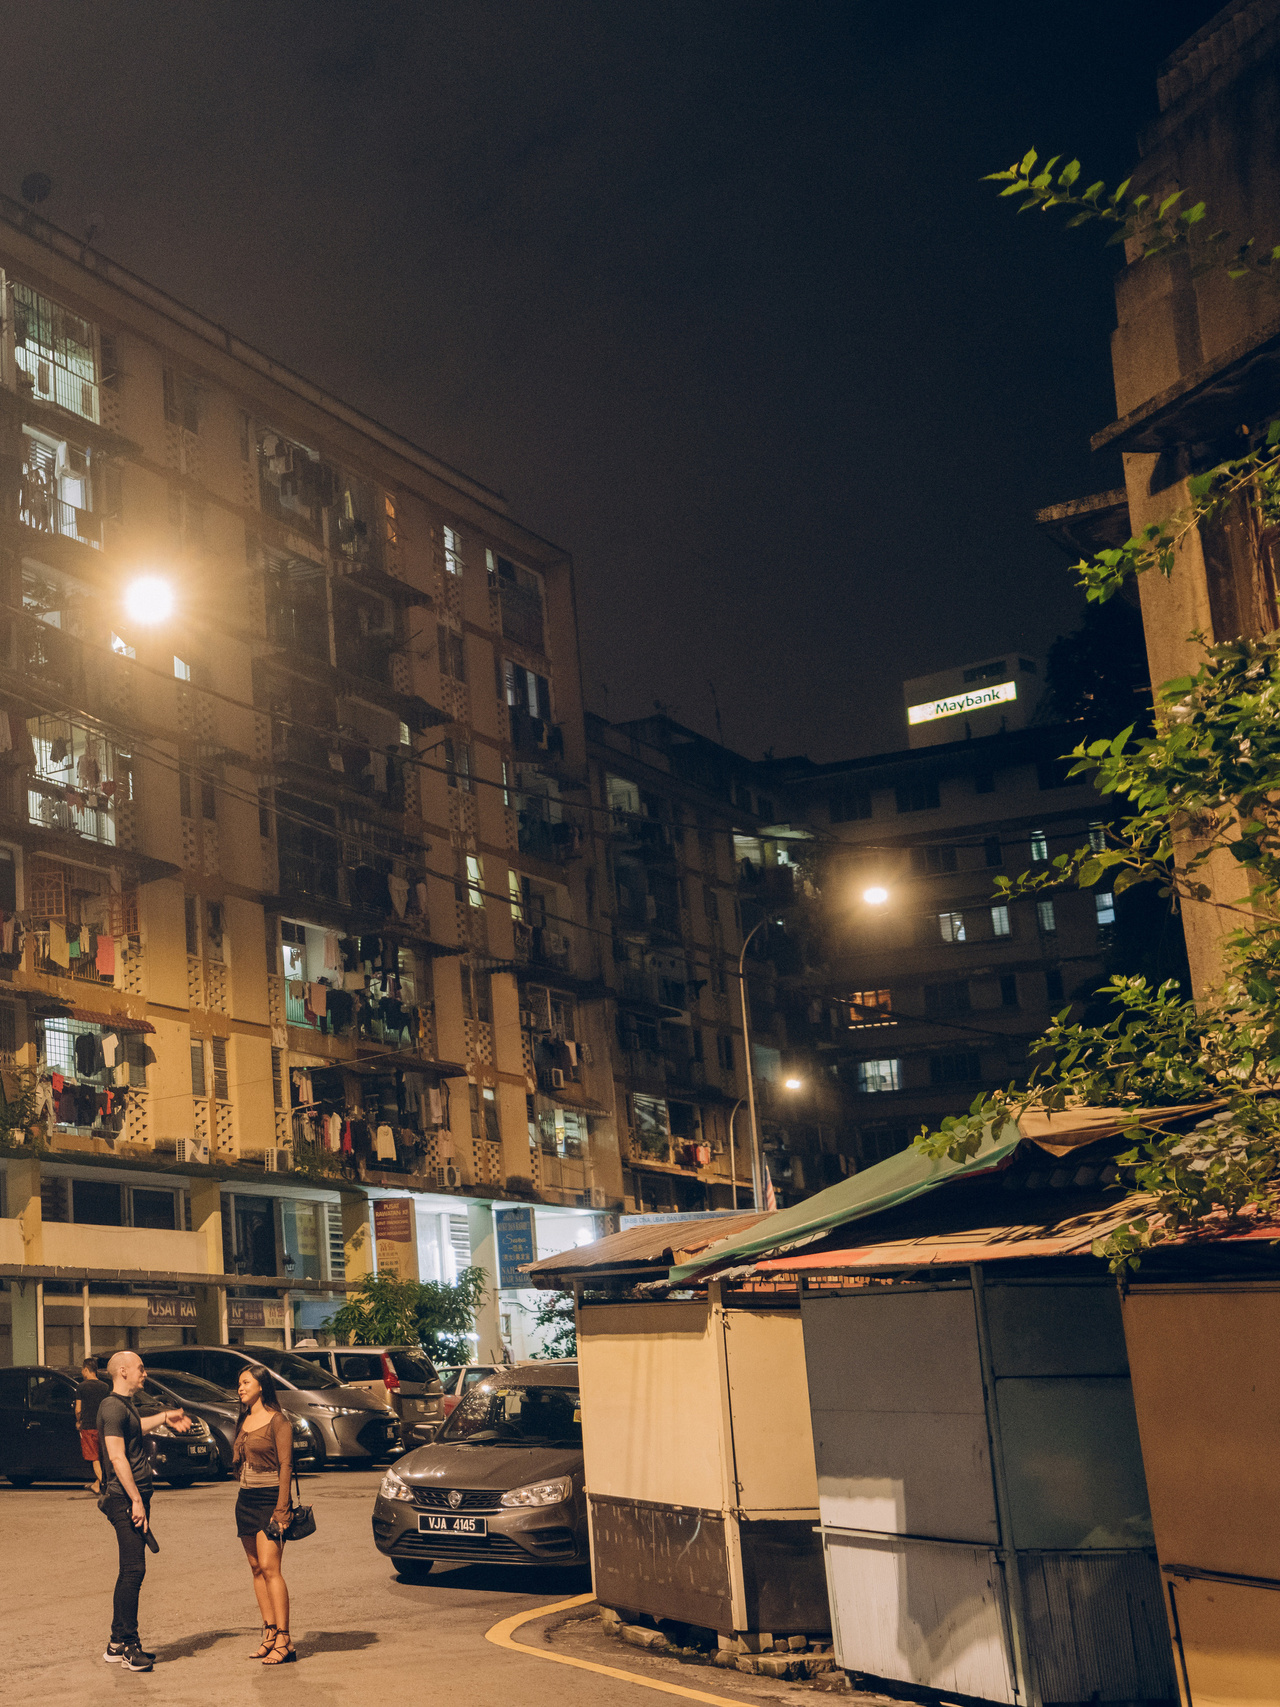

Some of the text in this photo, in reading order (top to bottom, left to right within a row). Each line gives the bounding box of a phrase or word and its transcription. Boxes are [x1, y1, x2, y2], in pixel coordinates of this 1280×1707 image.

[935, 689, 1001, 714] Maybank
[148, 1301, 176, 1316] PUSAT
[231, 1302, 244, 1318] KF
[428, 1517, 476, 1531] VJA 4145
